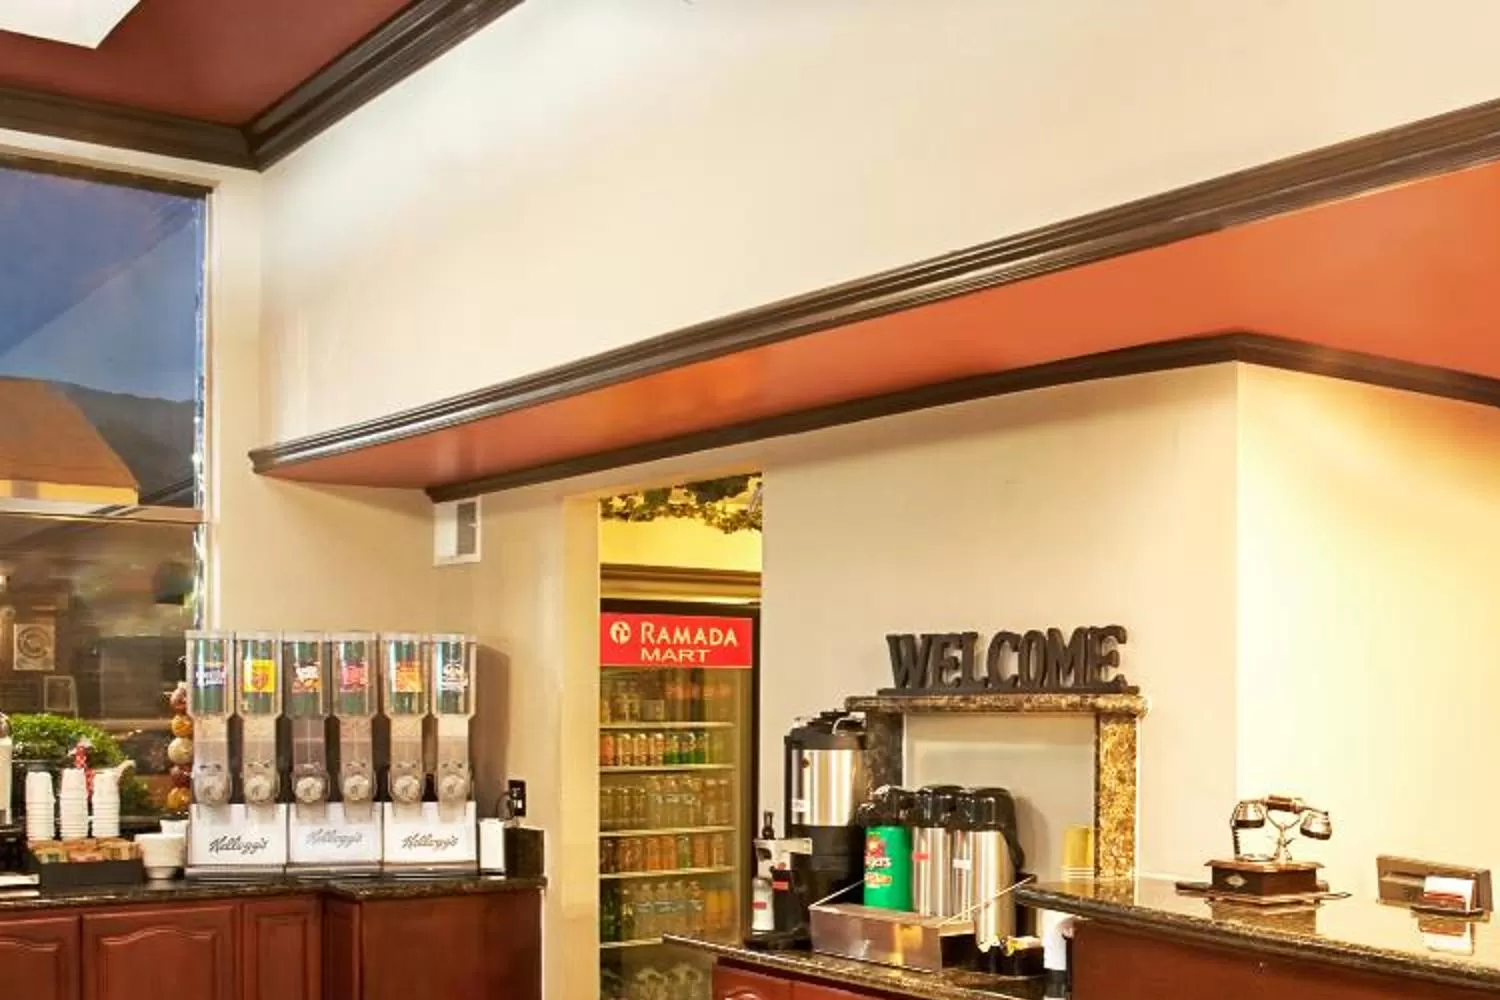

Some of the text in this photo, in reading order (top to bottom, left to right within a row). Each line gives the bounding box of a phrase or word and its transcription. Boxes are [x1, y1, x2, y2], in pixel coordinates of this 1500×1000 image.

[640, 621, 738, 647] RAMADA
[640, 647, 711, 663] MART
[886, 625, 1128, 689] WELCOME
[208, 834, 269, 854] Kellogg's
[305, 828, 363, 848] Kellogg's
[401, 832, 459, 851] Kellogg's
